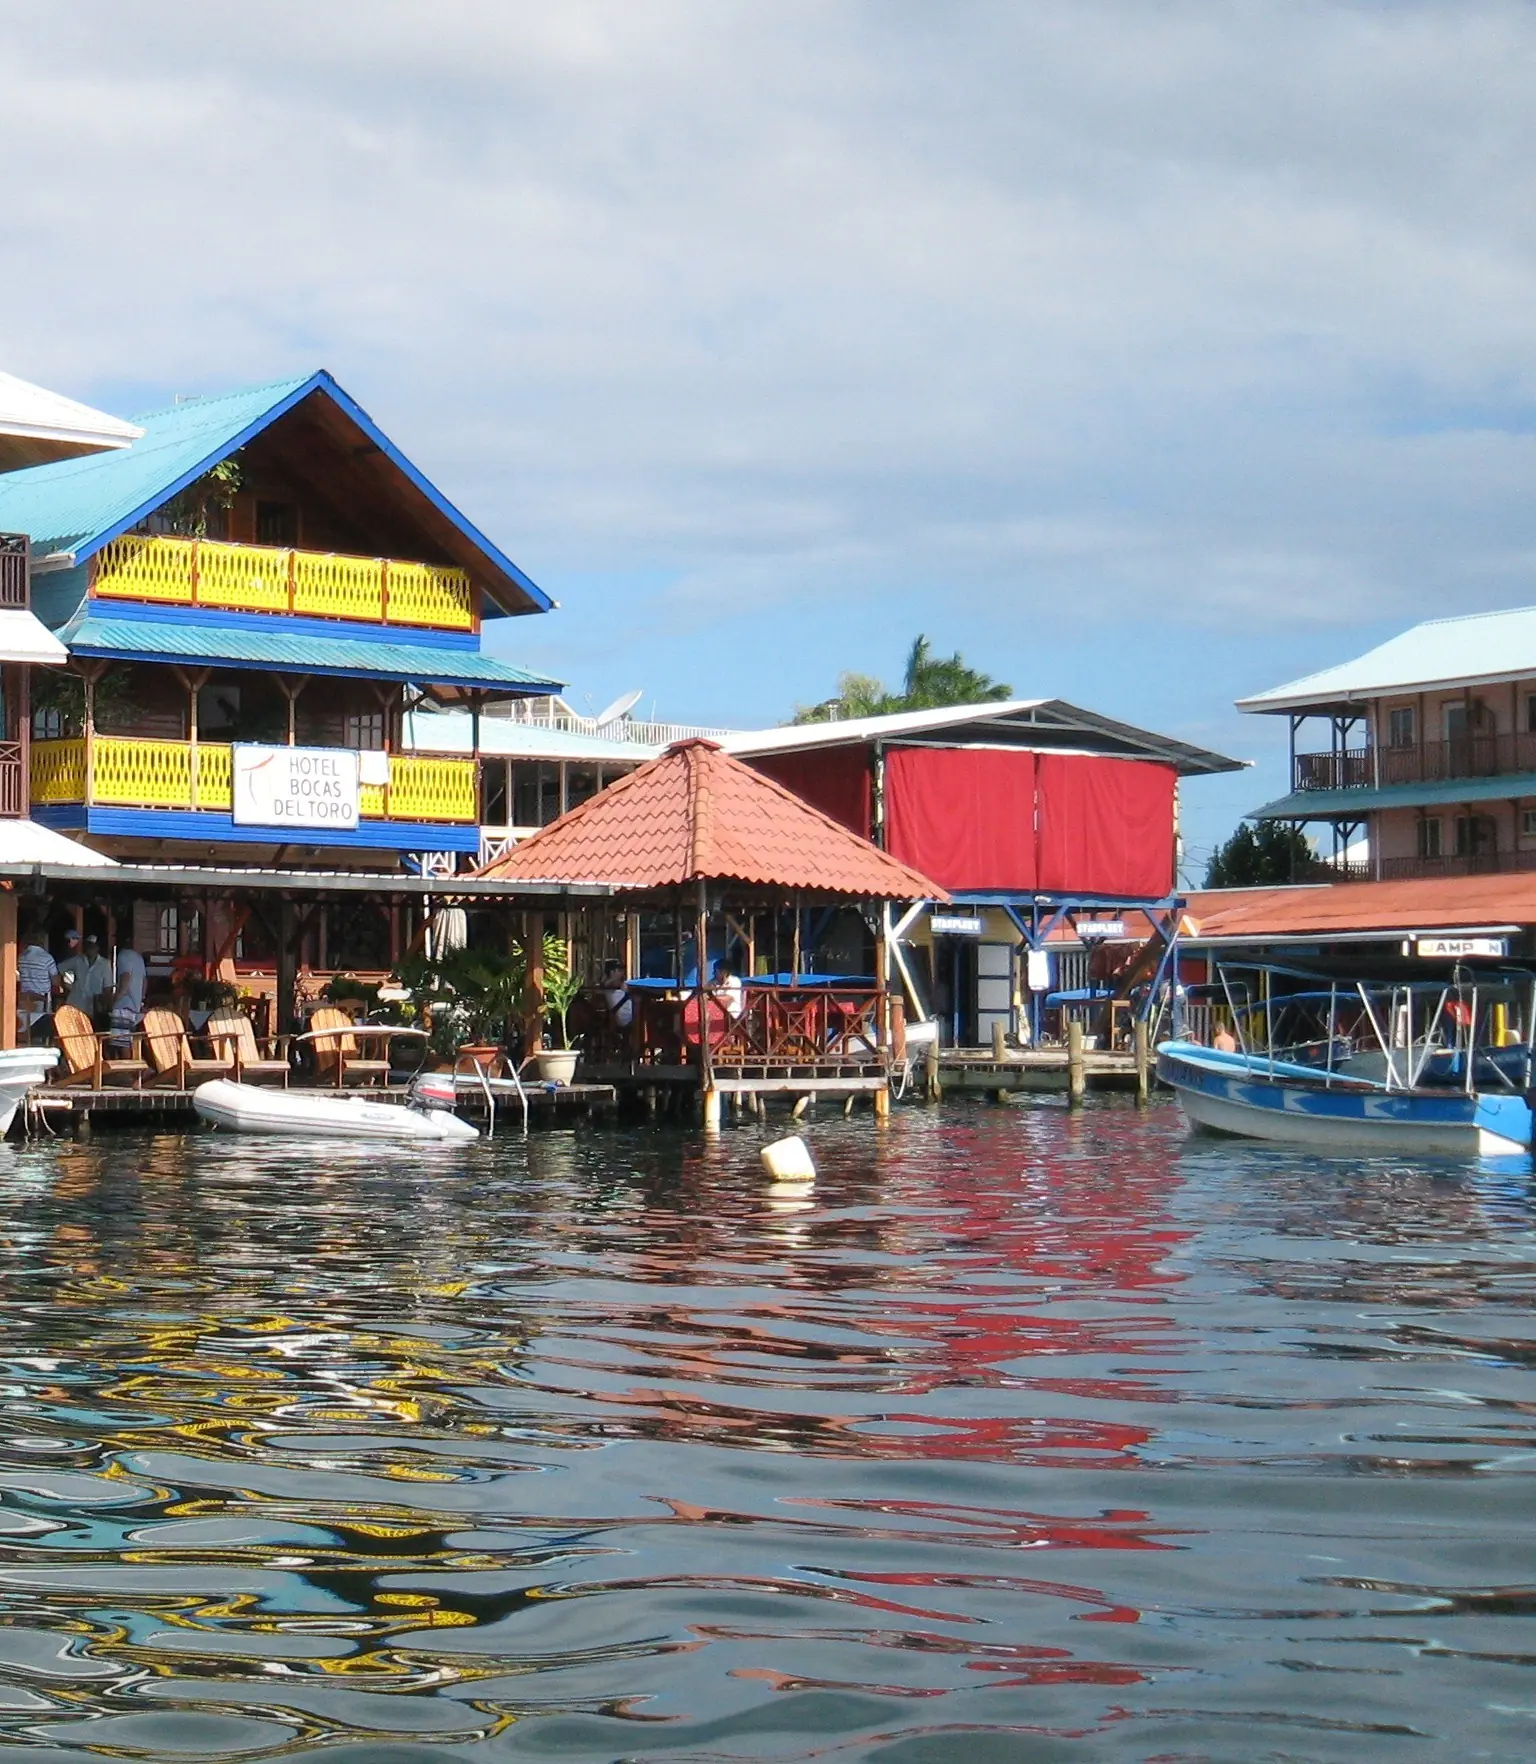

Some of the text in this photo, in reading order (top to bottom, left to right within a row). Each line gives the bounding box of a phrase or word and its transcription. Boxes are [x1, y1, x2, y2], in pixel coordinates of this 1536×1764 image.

[289, 756, 340, 777] HOTEL
[290, 778, 342, 798] BOCAS
[274, 798, 352, 820] DEL TORO
[1420, 942, 1500, 954] JAMPN
